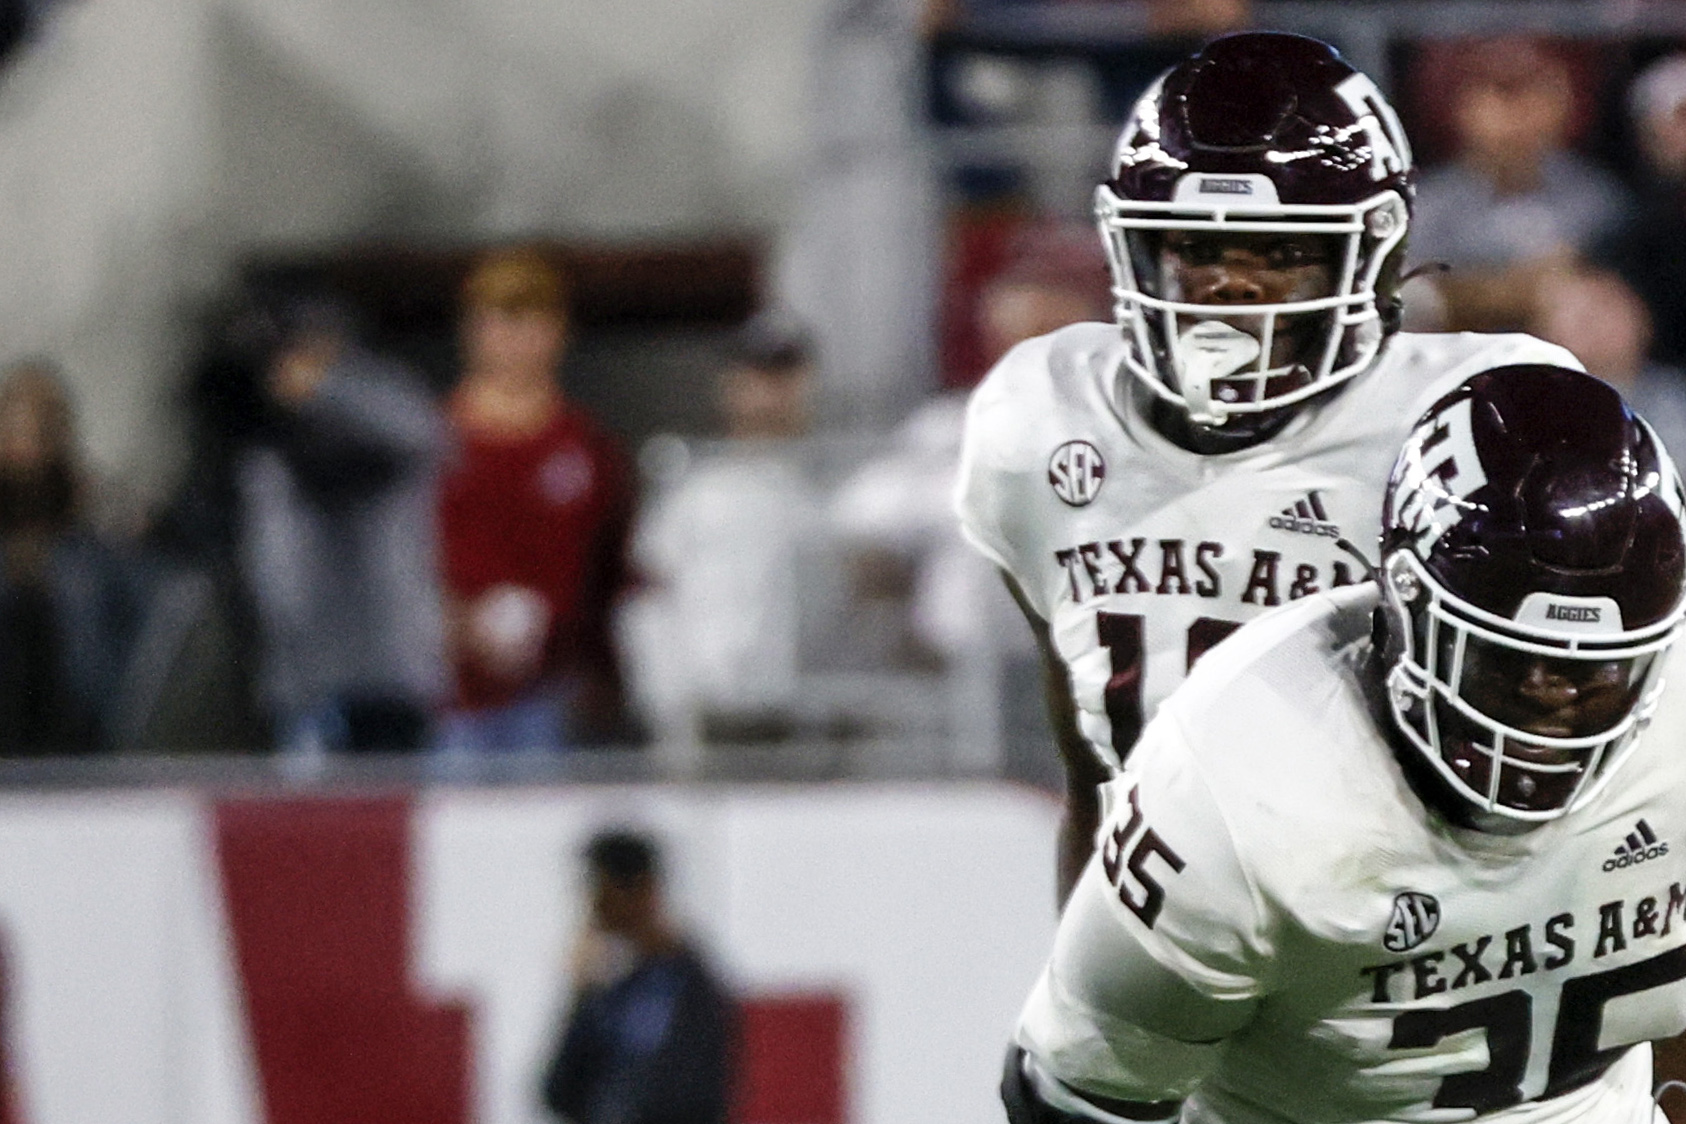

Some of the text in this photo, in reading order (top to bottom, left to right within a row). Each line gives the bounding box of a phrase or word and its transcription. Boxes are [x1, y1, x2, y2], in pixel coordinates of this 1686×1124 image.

[1049, 440, 1105, 506] SEC
[1269, 515, 1340, 539] adidas
[1055, 537, 1225, 603] TEXAS
[1545, 603, 1601, 622] AGGIES
[1103, 782, 1187, 931] 35
[1602, 842, 1670, 872] adidas
[1360, 911, 1576, 1004] TEXAS
